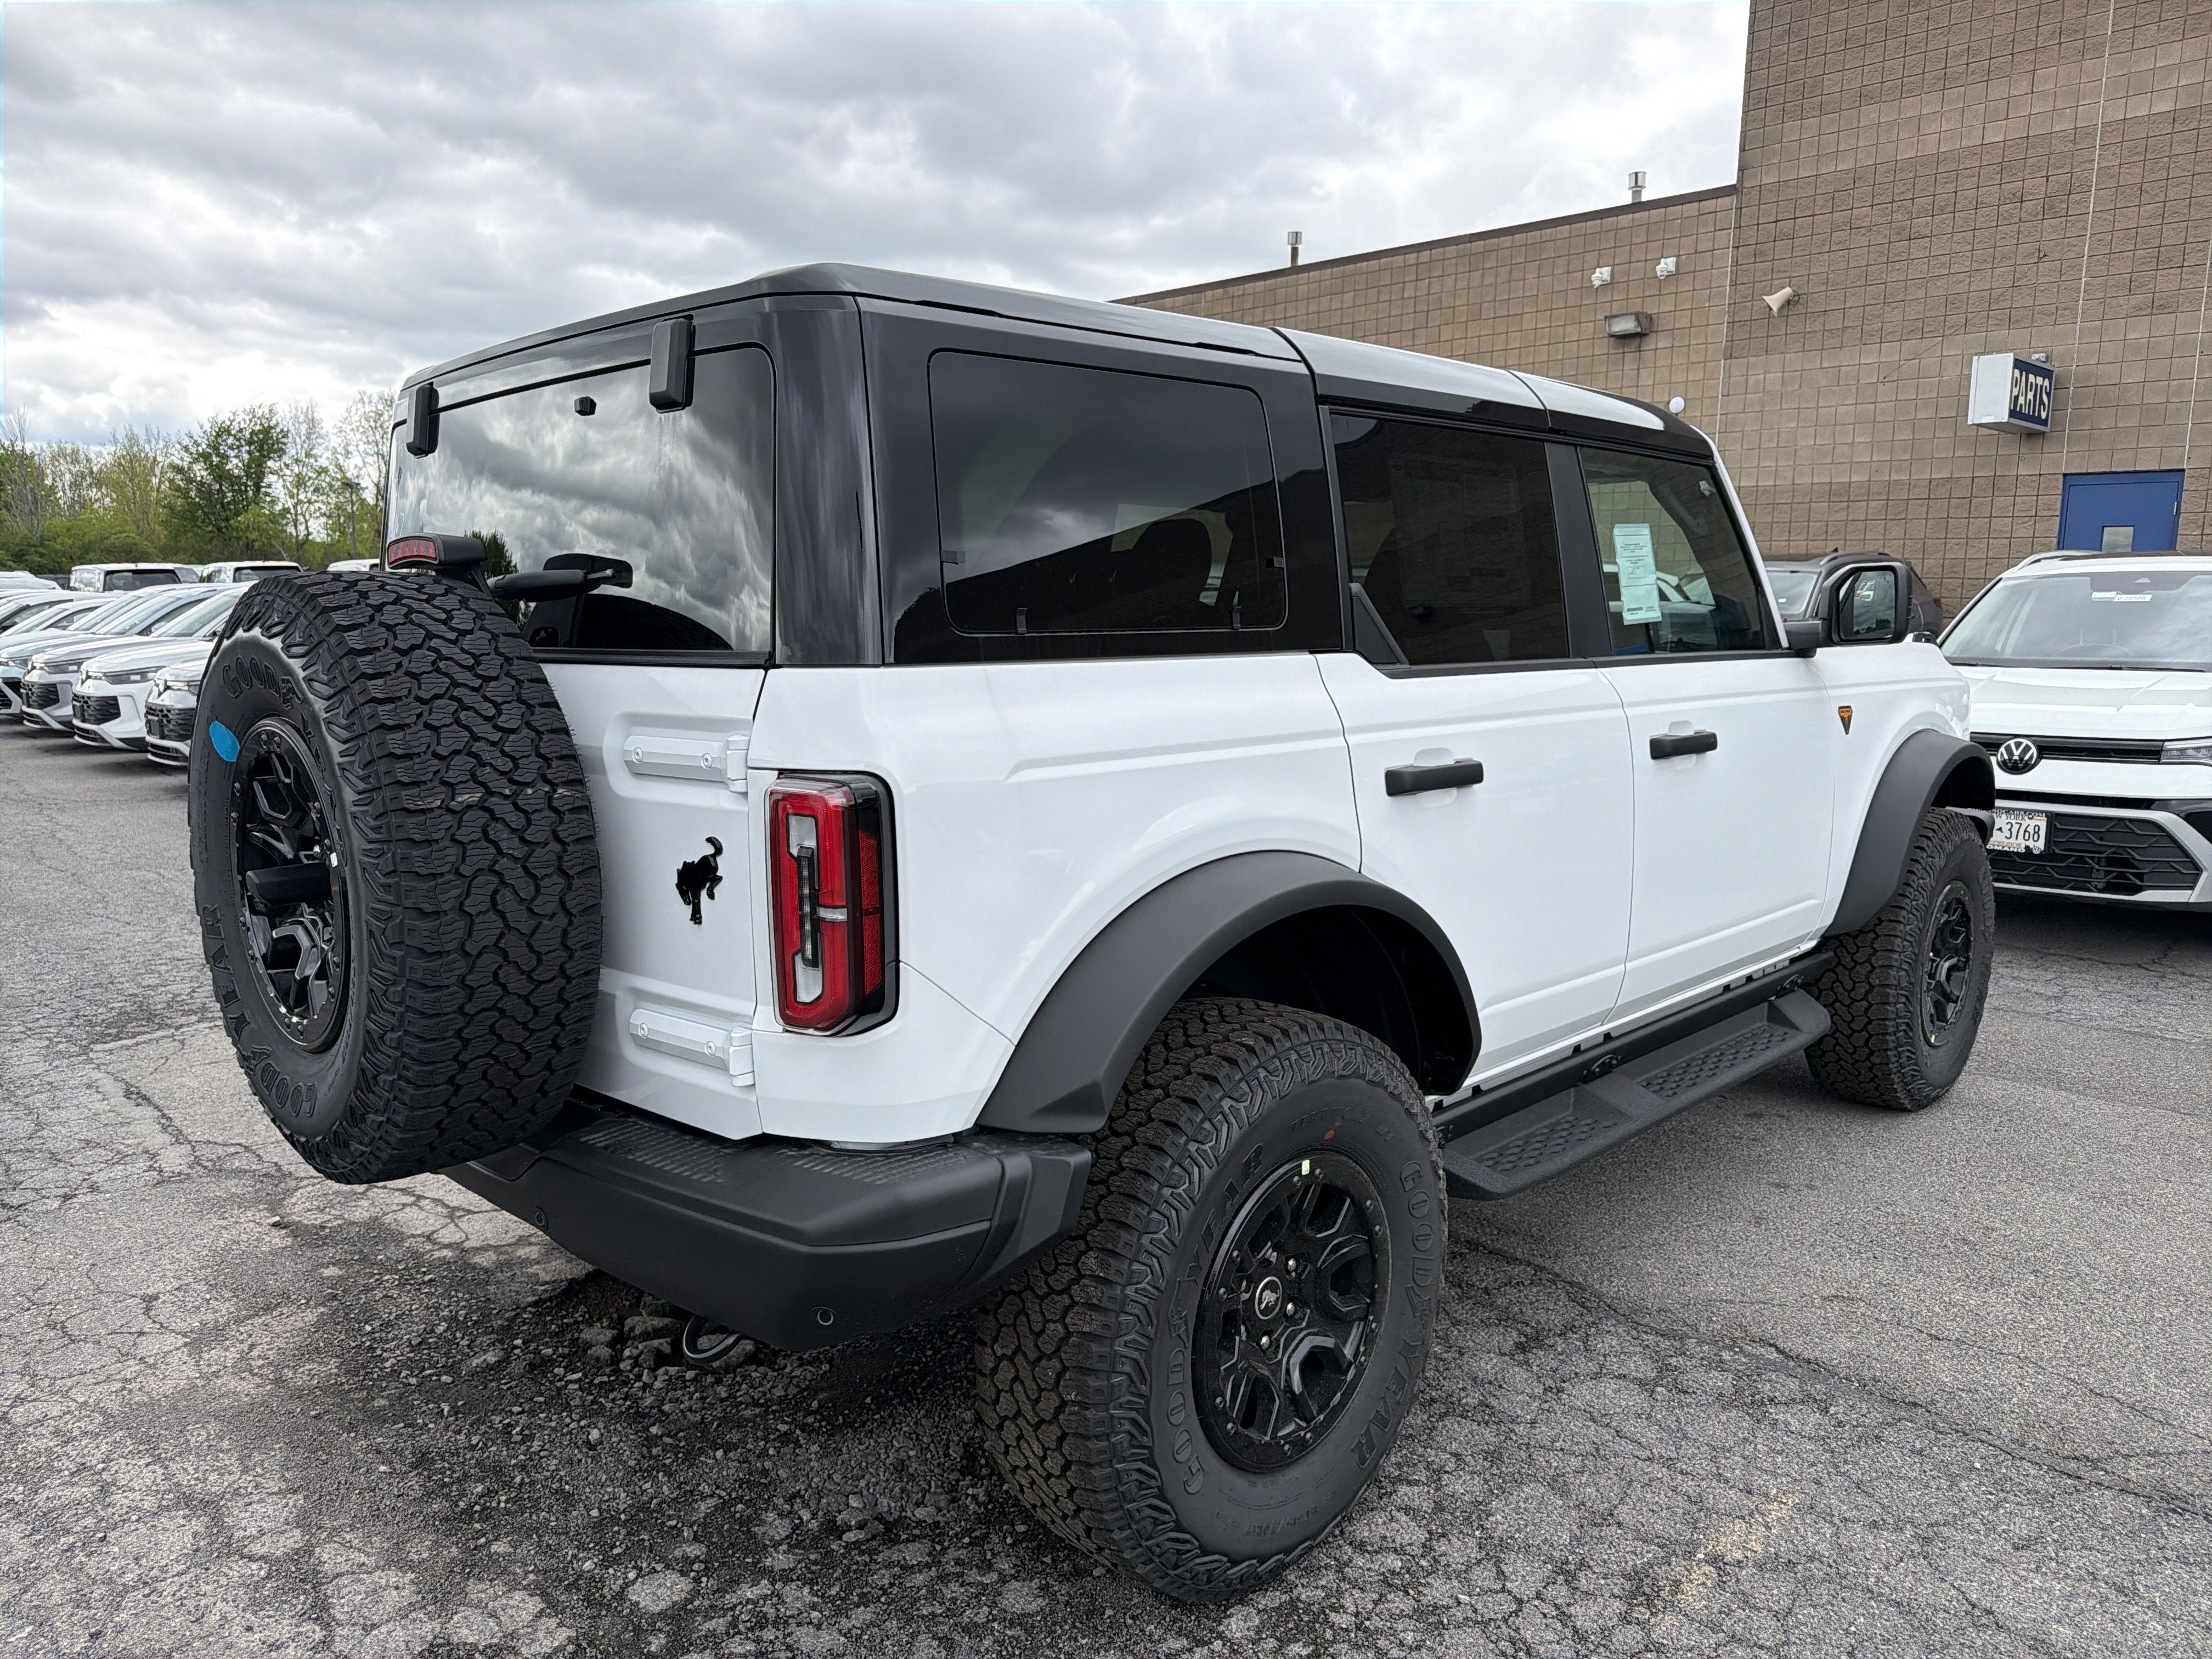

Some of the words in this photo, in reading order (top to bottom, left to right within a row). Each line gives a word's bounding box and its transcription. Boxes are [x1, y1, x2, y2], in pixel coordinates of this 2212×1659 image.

[2011, 368, 2050, 420] PARTS
[2004, 821, 2040, 843] 3768
[1986, 844, 2025, 853] OMANO
